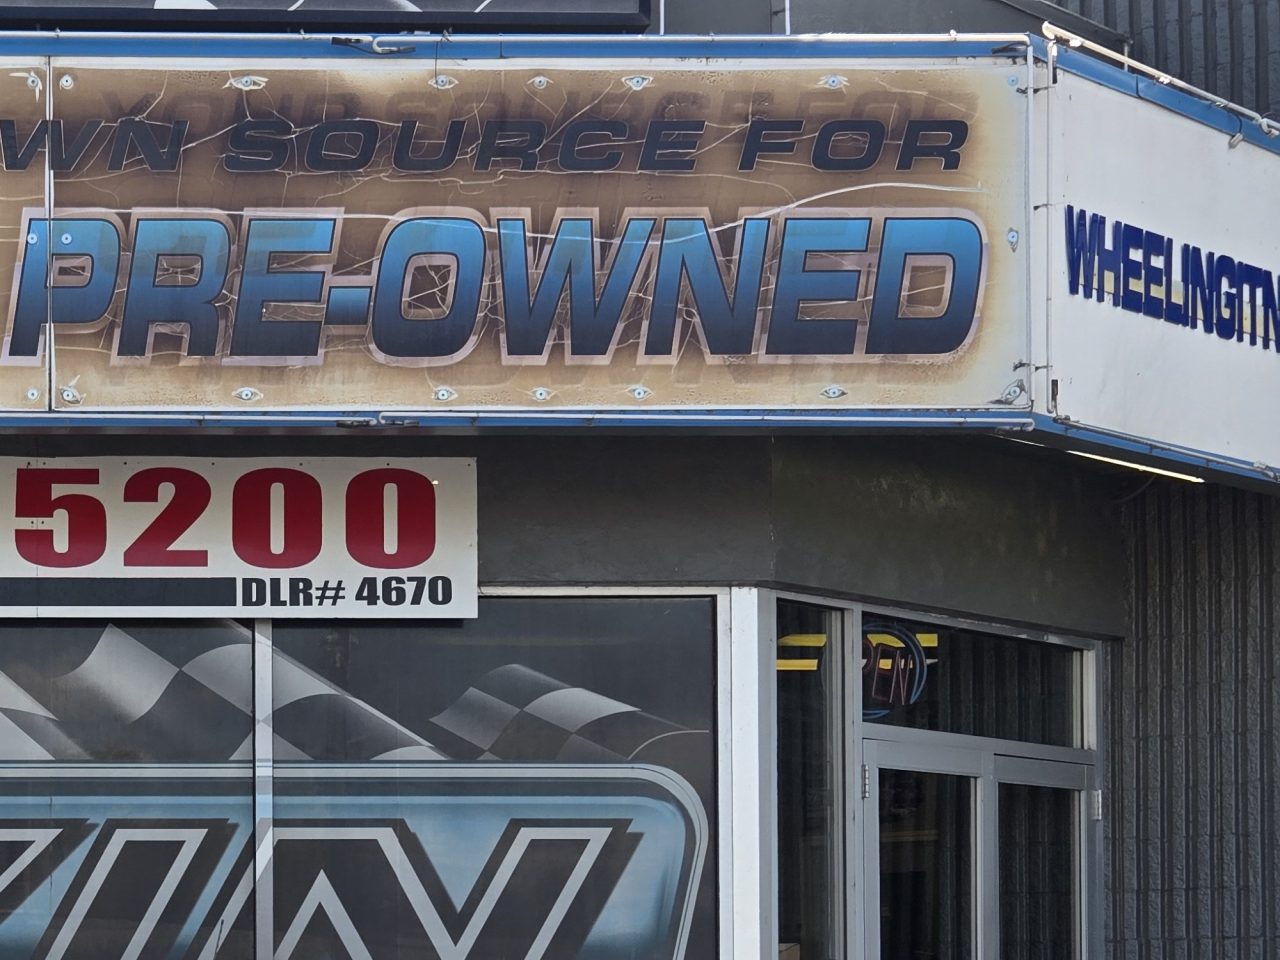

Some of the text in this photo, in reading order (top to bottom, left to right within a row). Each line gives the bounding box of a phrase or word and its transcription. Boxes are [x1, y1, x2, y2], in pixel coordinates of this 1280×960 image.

[222, 118, 707, 173] SOURCE
[737, 118, 970, 172] FOR
[1, 208, 987, 366] PRE-OWNED
[240, 575, 453, 607] DLR# 4670
